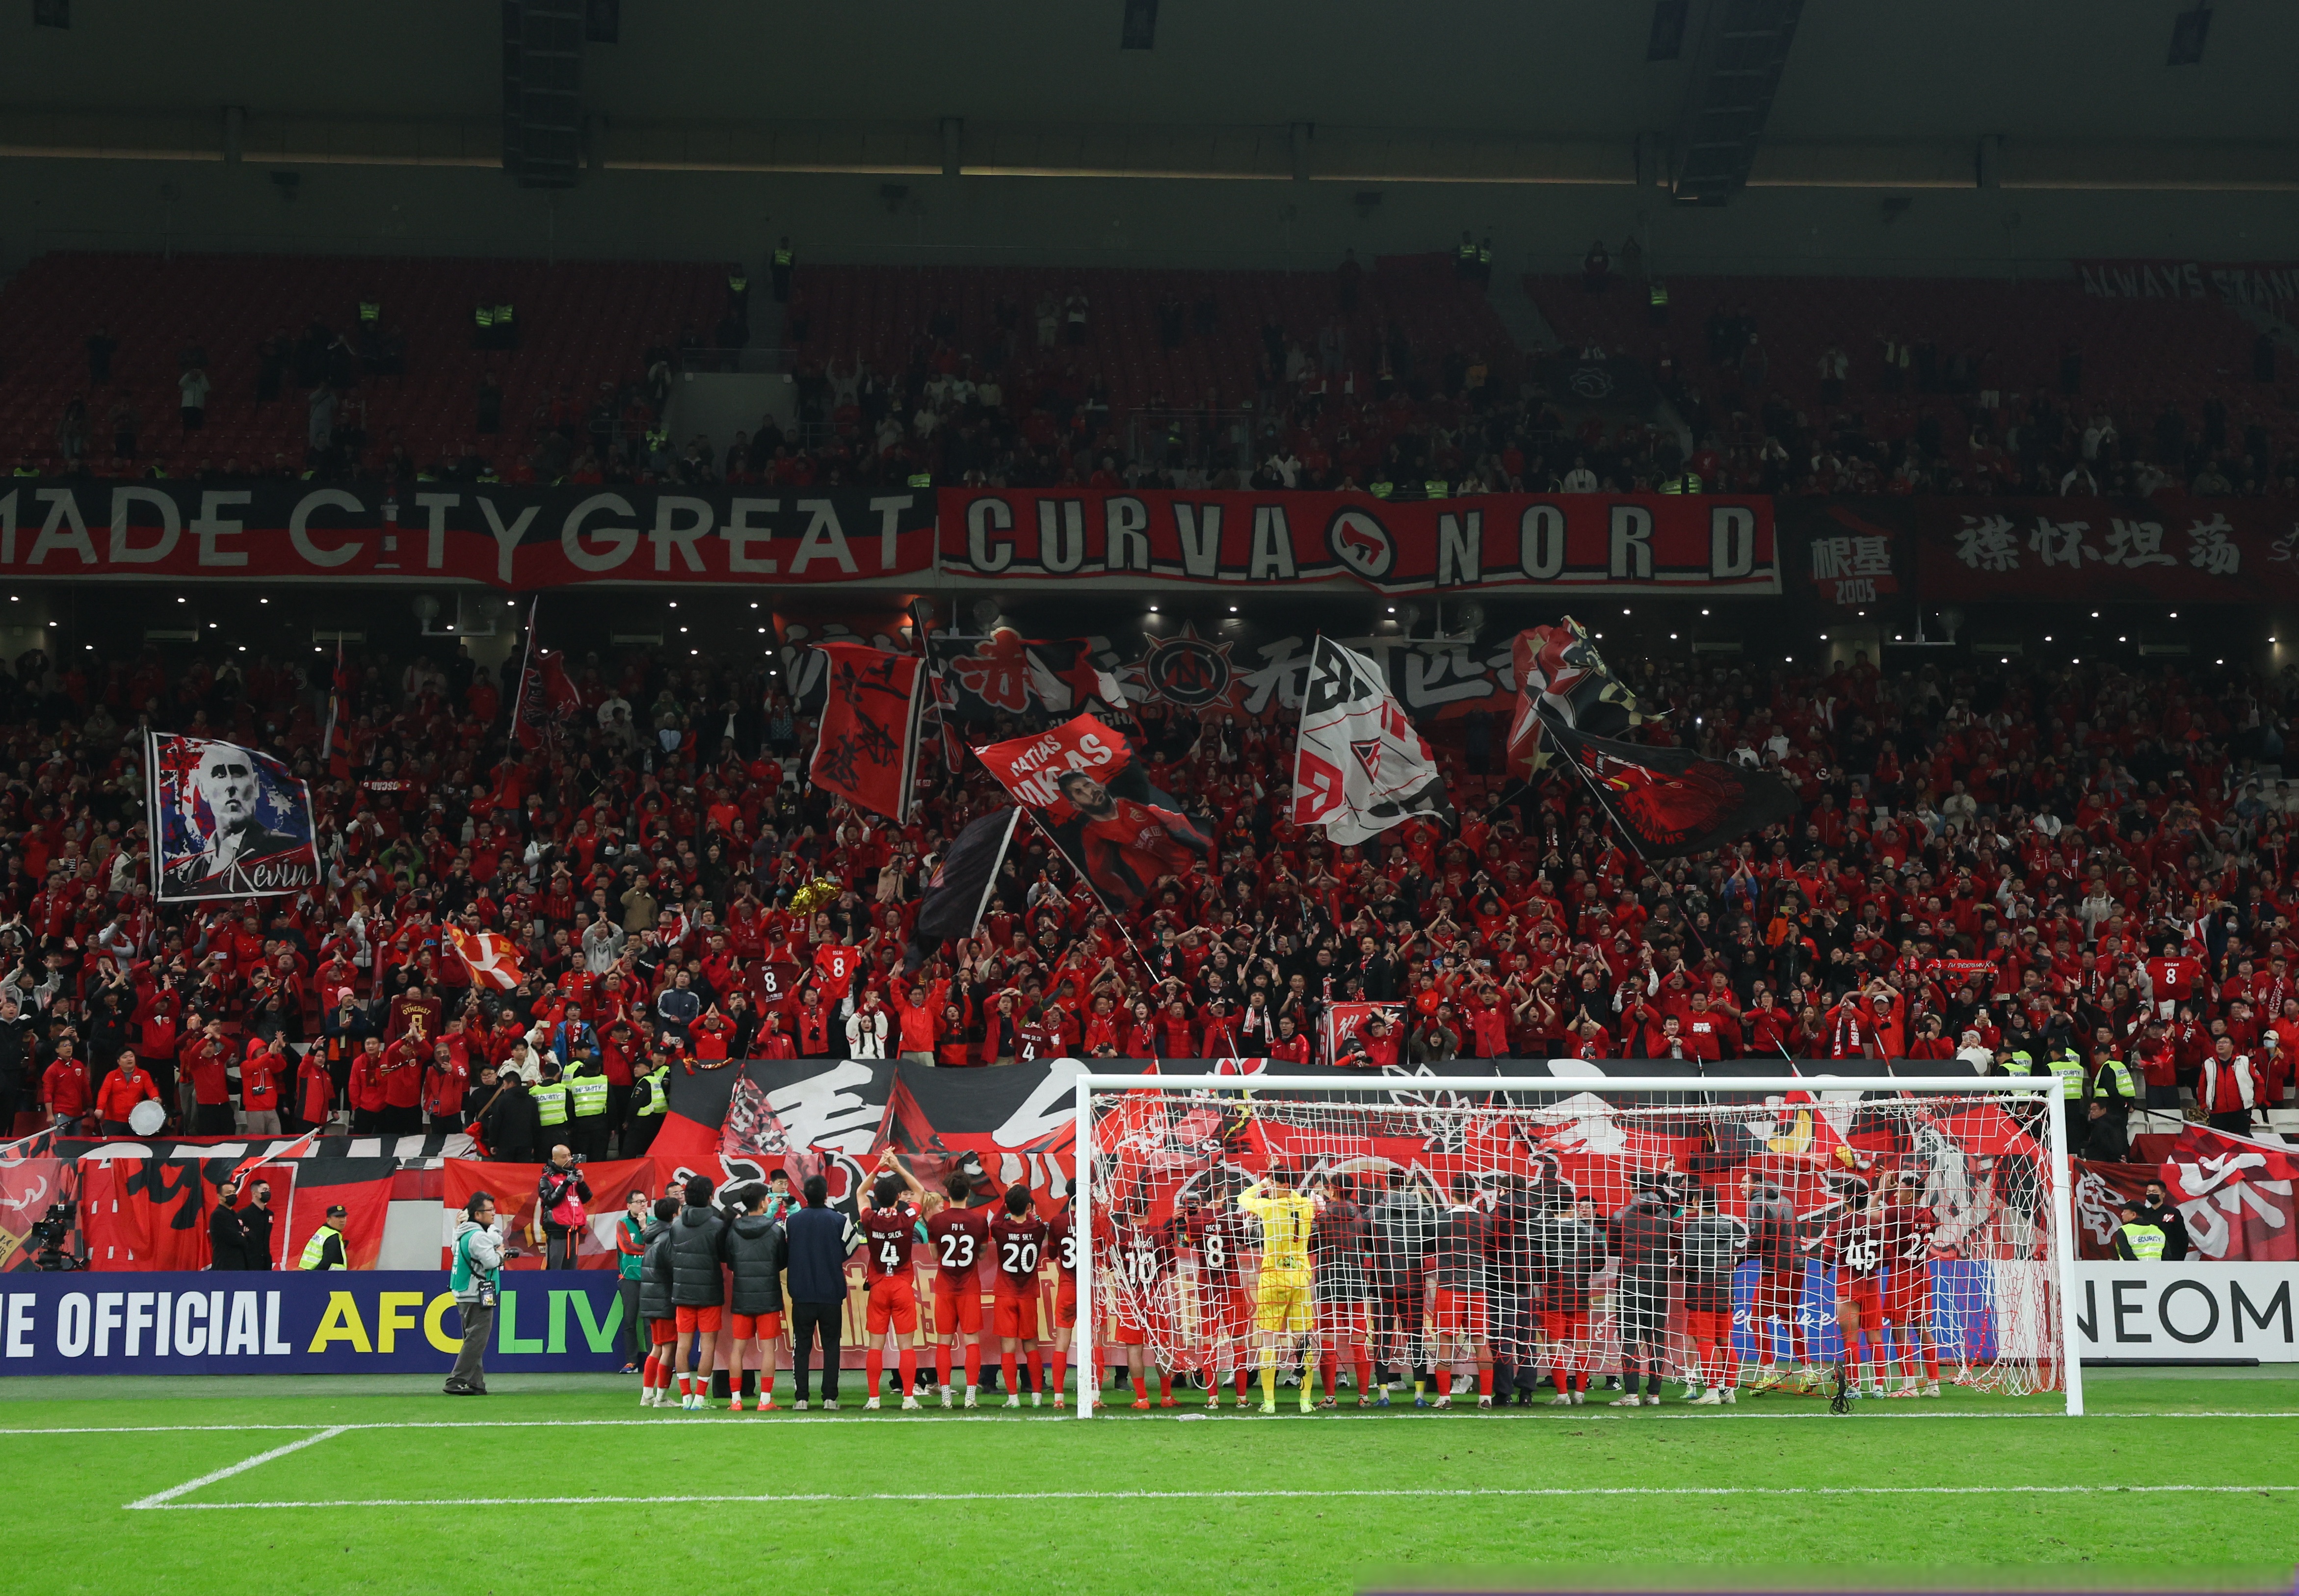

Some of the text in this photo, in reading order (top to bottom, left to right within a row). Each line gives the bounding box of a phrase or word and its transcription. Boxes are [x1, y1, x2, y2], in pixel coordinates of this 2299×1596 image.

[2082, 262, 2299, 306] ALWAYS STAN
[561, 492, 914, 574] GREAT
[967, 495, 1756, 589] CURVA NORD
[1810, 535, 1893, 580] 根基
[1835, 578, 1876, 605] 2005
[220, 847, 314, 893] Kevin
[764, 971, 777, 992] 8
[833, 957, 845, 978] 8
[2166, 968, 2176, 984] 8
[1022, 1042, 1034, 1062] 4
[872, 1230, 886, 1240] WANG
[1022, 1233, 1034, 1241] SH.Y.
[1290, 1211, 1299, 1243] 1
[2133, 1235, 2162, 1244] SECURITY
[880, 1241, 900, 1266] 4
[940, 1234, 975, 1268] 23
[1003, 1243, 1038, 1273] 20
[1207, 1235, 1225, 1268] 8
[1845, 1239, 1877, 1271] 45
[1903, 1232, 1934, 1261] 22
[1125, 1252, 1157, 1284] 10
[56, 1291, 291, 1357] OFFICIAL
[307, 1291, 464, 1354] AFC
[498, 1290, 648, 1354] LIV
